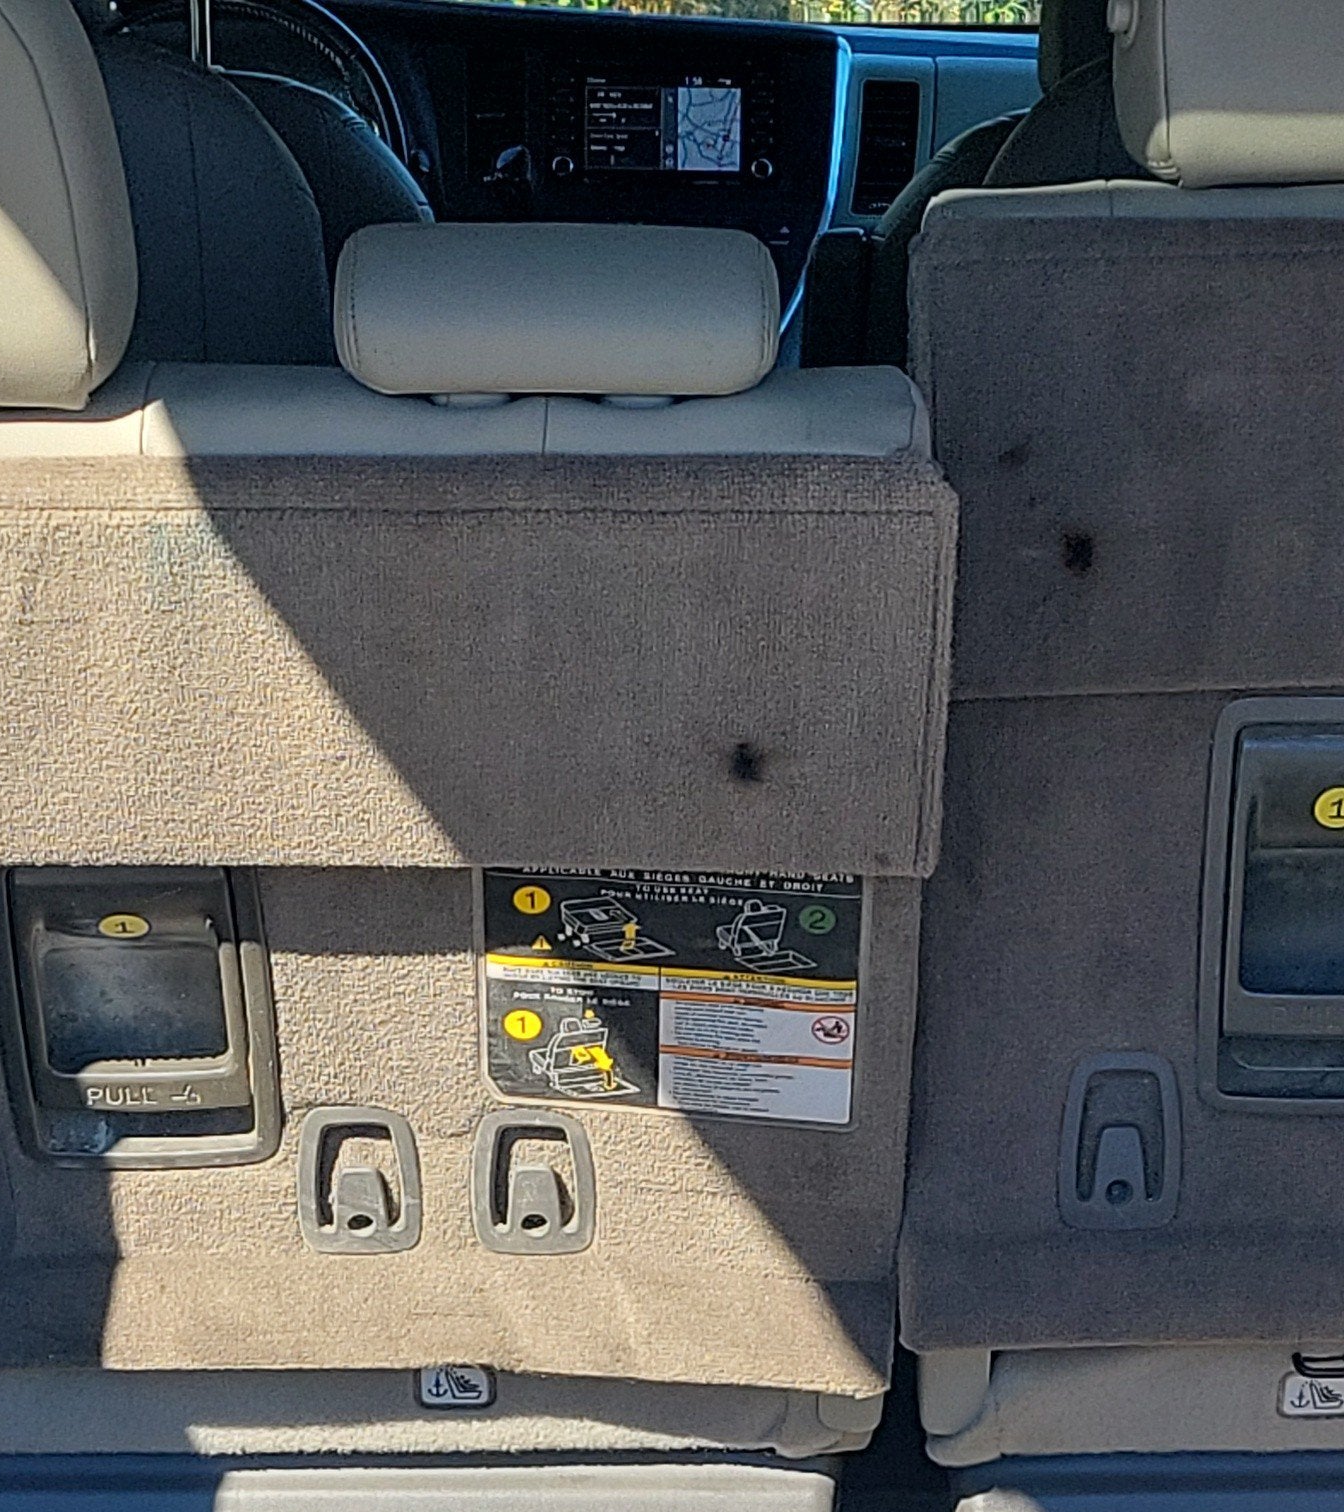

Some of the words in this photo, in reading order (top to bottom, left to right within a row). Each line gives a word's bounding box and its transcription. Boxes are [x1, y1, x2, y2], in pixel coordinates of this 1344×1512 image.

[698, 874, 752, 887] GAUCHE
[783, 881, 823, 893] DROIT
[809, 909, 826, 930] 2
[86, 1086, 159, 1106] PULL
